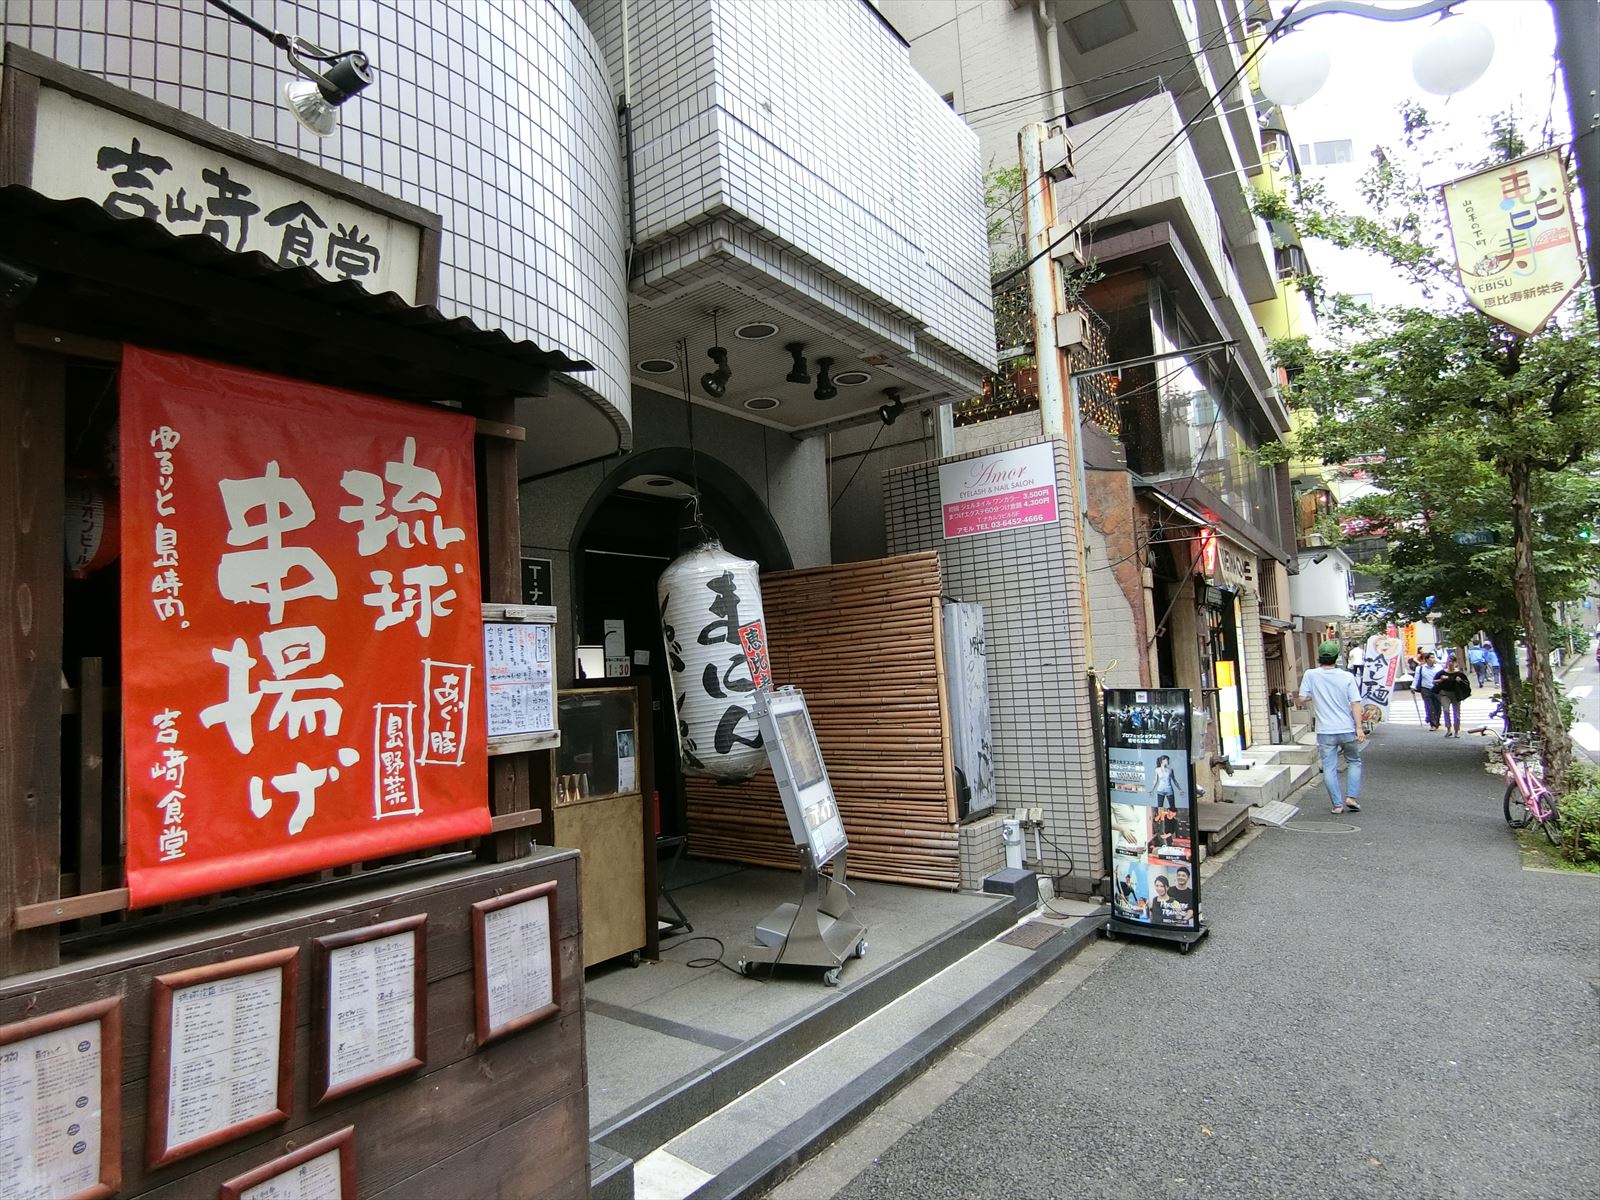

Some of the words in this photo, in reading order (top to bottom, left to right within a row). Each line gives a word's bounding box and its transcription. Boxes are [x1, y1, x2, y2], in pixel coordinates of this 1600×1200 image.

[1462, 199, 1487, 246] 山の手の下町
[1470, 278, 1513, 294] YEBISU
[1483, 281, 1564, 308] 恵比寿新栄会
[960, 489, 987, 498] EYELASH
[1011, 479, 1034, 488] SALON
[964, 459, 1028, 489] Amor
[340, 436, 467, 637] 琉球
[528, 565, 544, 605] T・ナ
[199, 460, 360, 835] 串揚げ
[433, 673, 464, 754] あぐー豚
[381, 713, 407, 805] 島野菜
